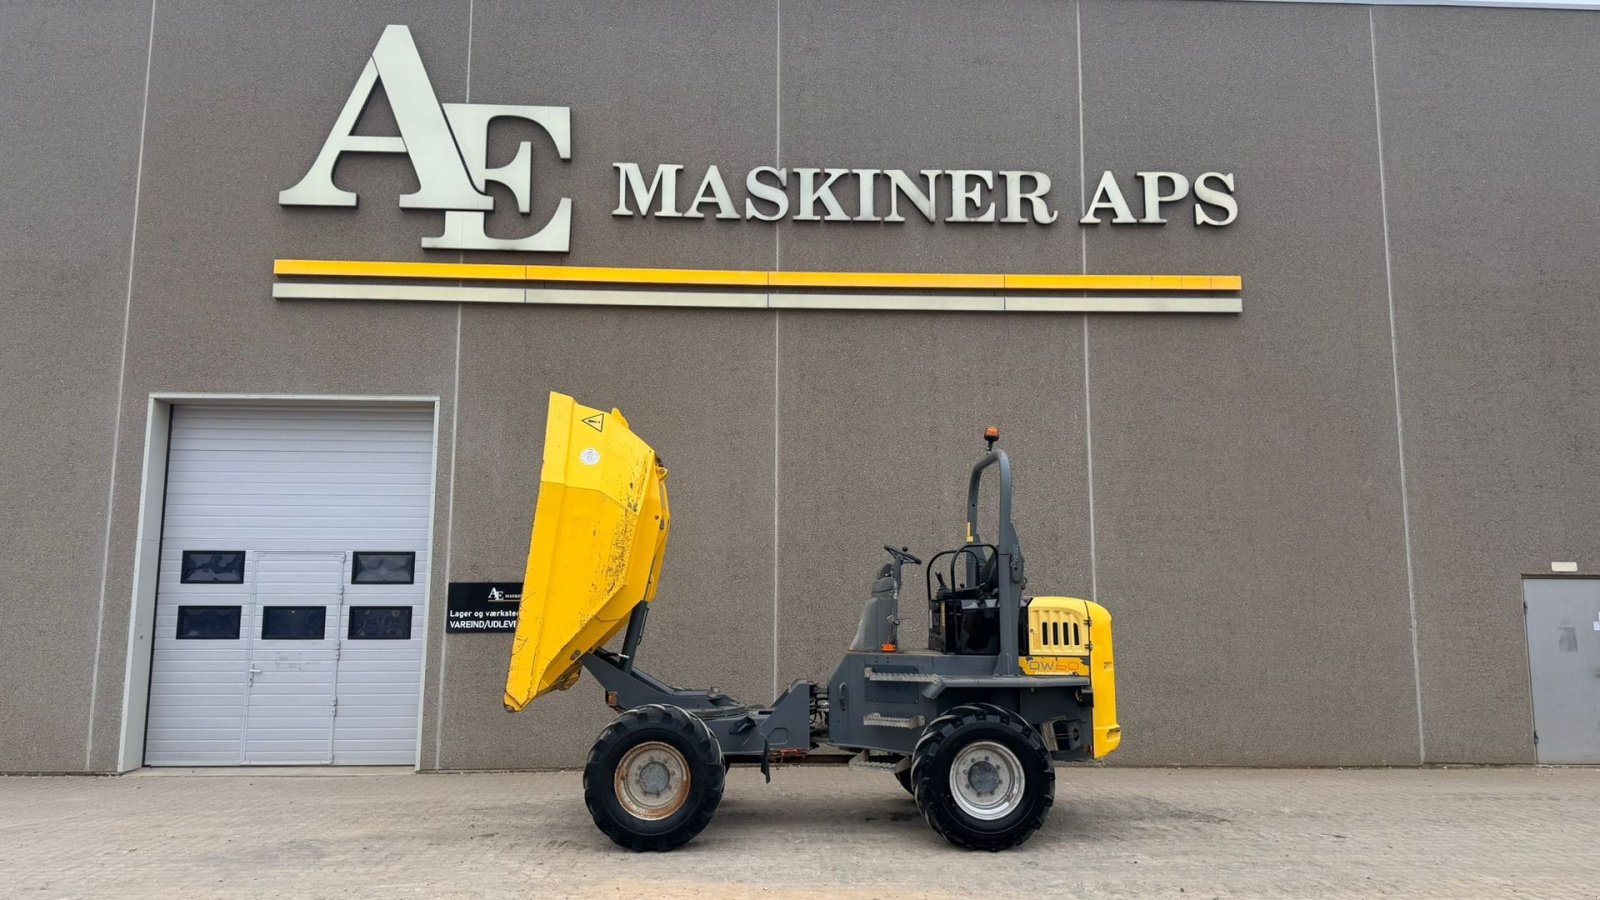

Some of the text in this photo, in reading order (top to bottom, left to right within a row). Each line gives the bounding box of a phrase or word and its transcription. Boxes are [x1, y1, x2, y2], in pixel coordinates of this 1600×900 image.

[279, 24, 1239, 253] AE MASKINER APS
[449, 609, 472, 618] Lager
[474, 610, 484, 618] og
[1029, 661, 1080, 671] DW60
